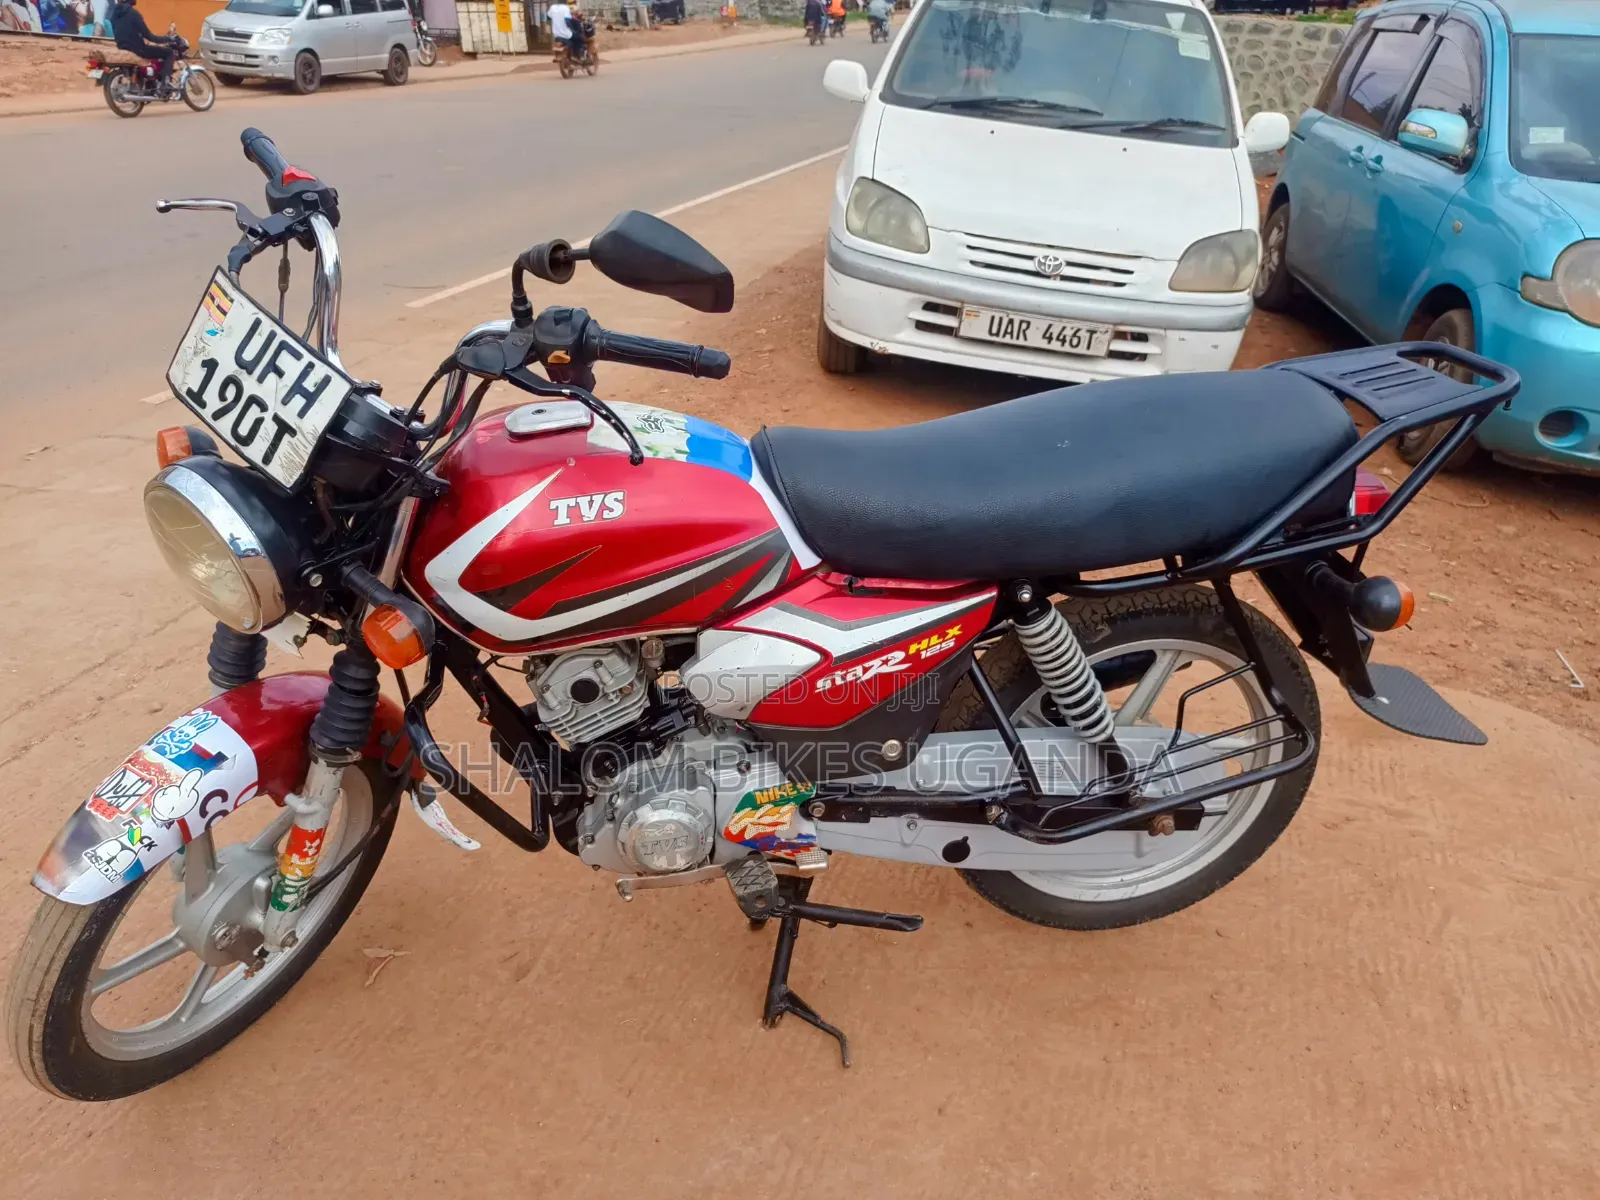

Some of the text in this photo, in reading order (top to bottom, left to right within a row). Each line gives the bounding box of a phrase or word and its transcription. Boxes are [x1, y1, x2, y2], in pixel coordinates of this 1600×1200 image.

[987, 314, 1098, 351] UAR 446T
[234, 316, 332, 420] UFH
[186, 357, 297, 466] 190T
[550, 490, 625, 527] TVS
[908, 624, 963, 655] HLX
[920, 638, 956, 660] 125
[88, 799, 118, 820] BEER
[754, 783, 798, 806] NIKE
[121, 819, 158, 852] FCK
